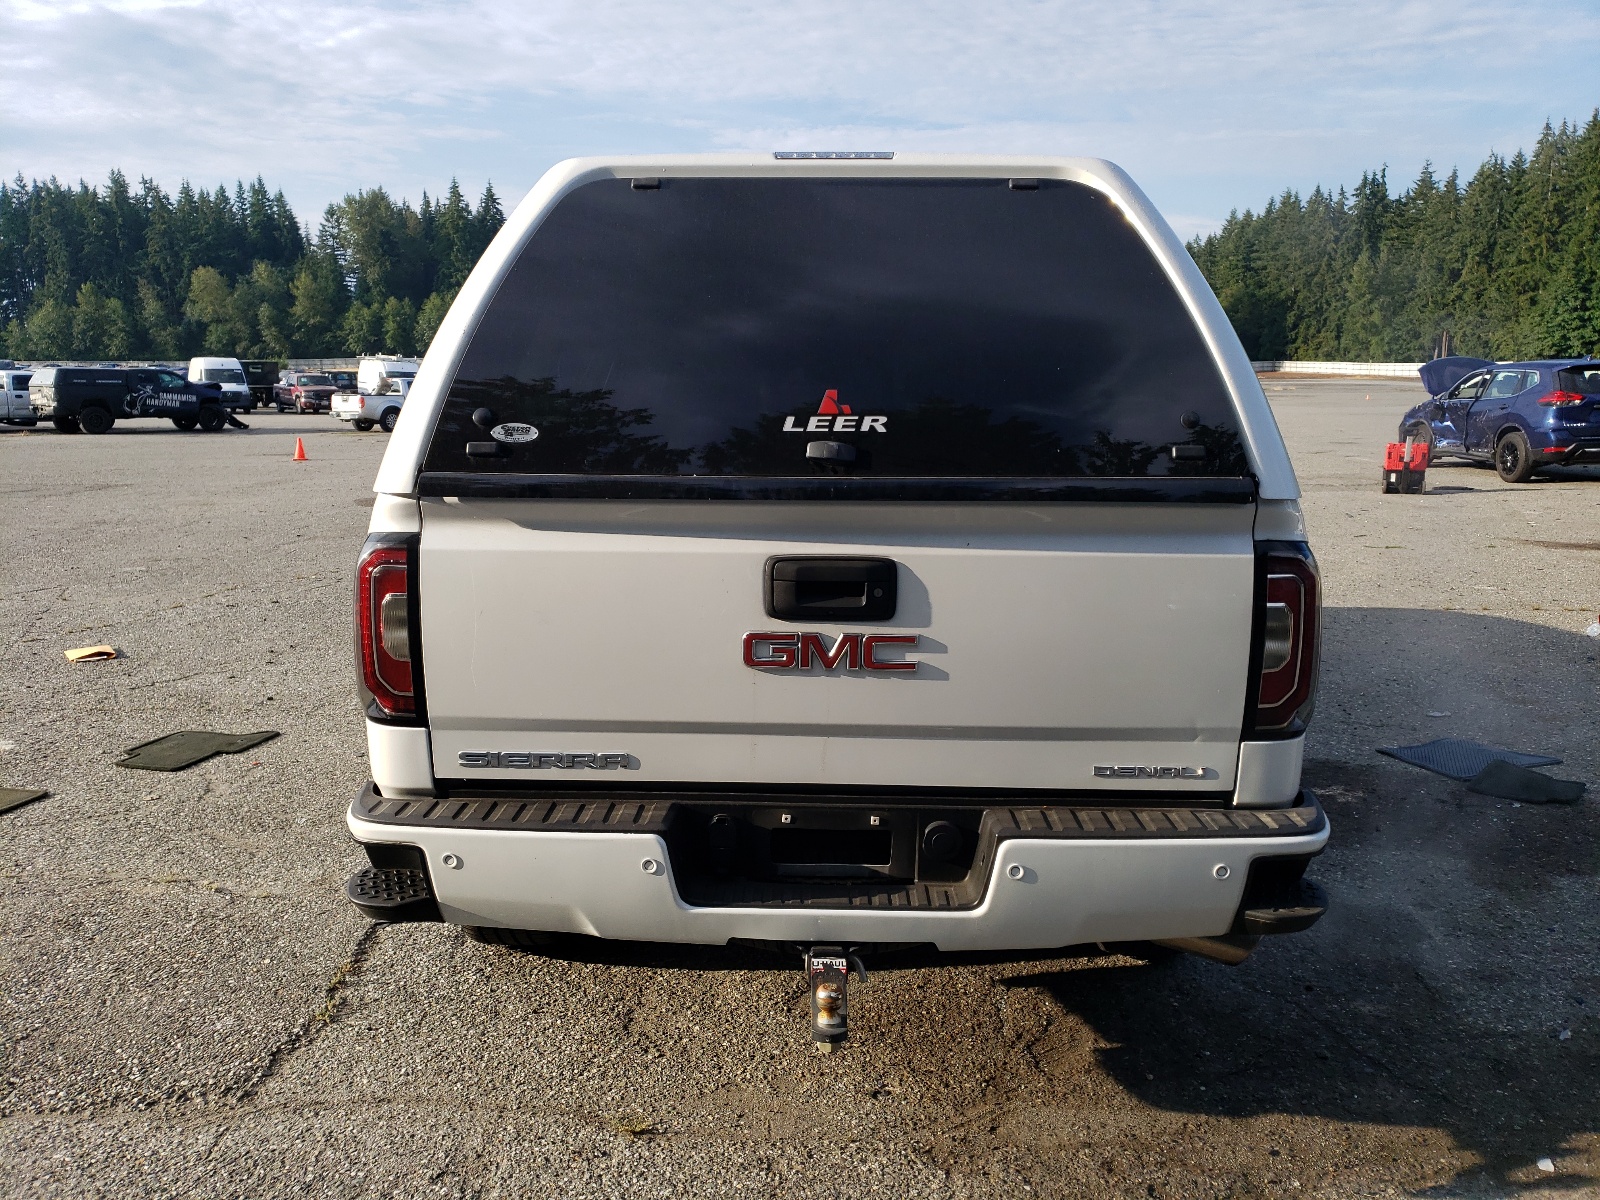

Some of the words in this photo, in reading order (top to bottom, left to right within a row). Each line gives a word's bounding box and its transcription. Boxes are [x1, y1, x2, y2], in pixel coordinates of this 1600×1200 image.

[146, 398, 180, 407] HANDYMAN
[782, 415, 888, 432] LEER
[742, 631, 918, 671] GMC
[458, 751, 628, 768] SIERRA
[1092, 765, 1206, 778] DENALI
